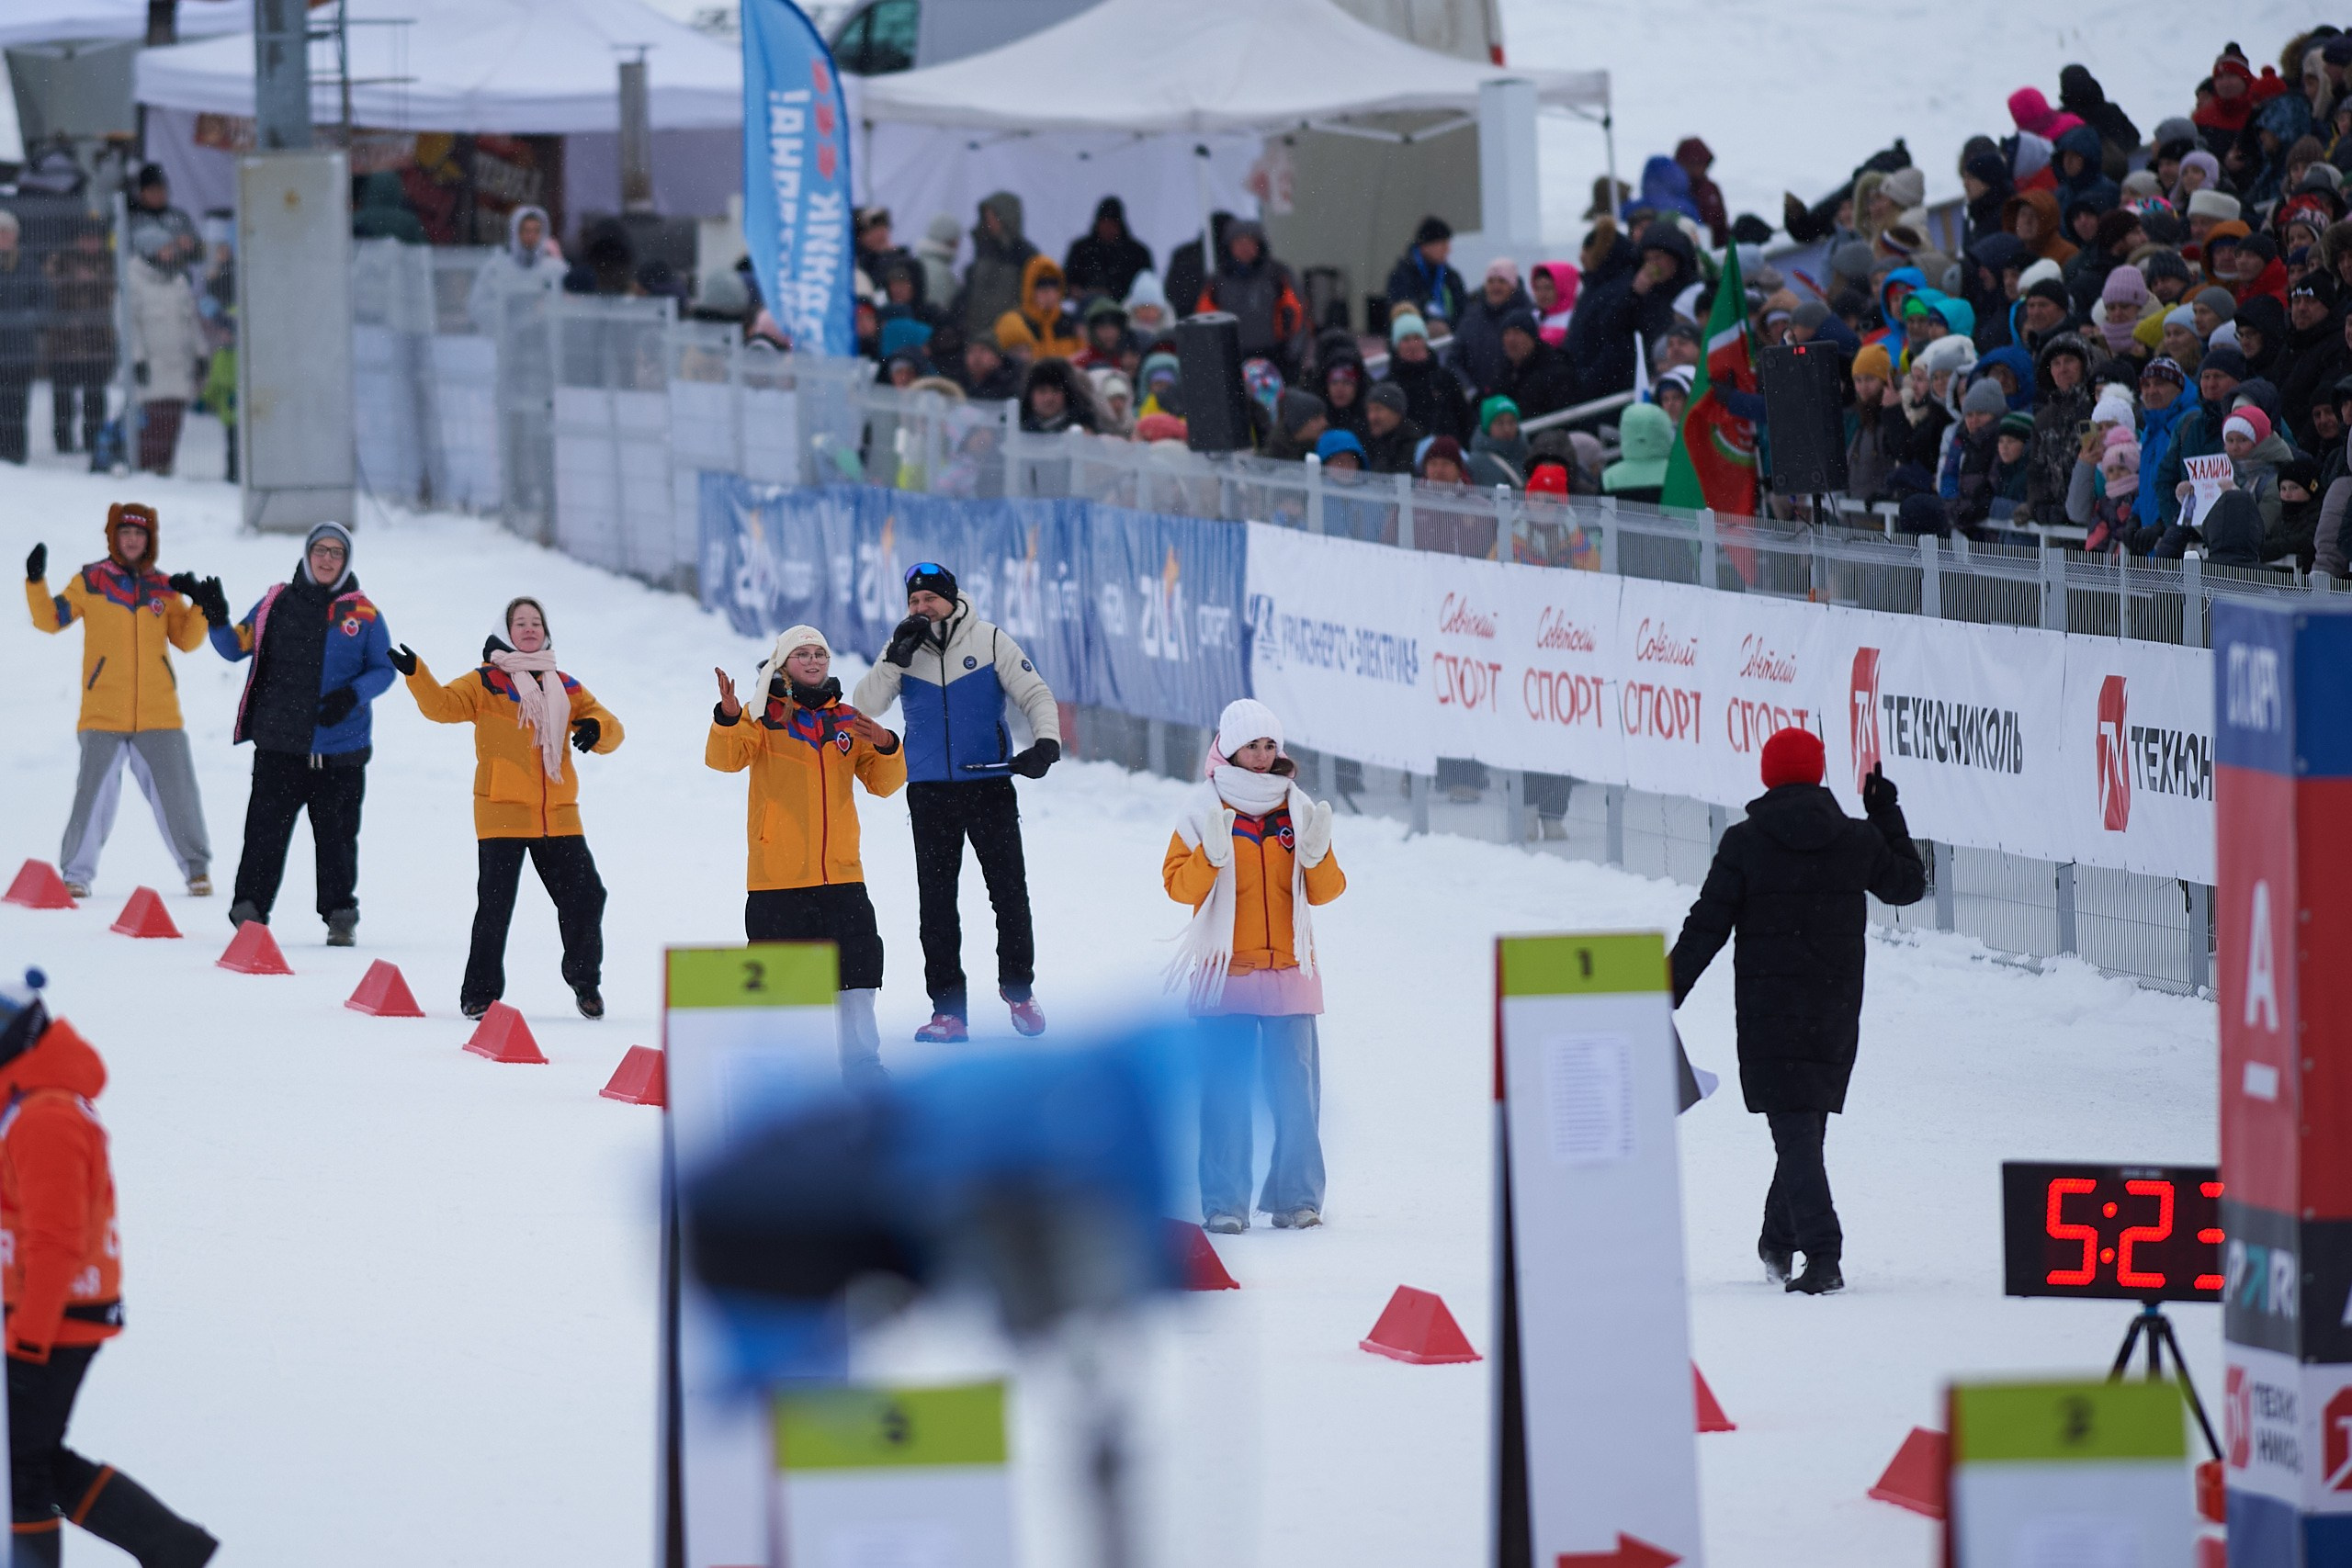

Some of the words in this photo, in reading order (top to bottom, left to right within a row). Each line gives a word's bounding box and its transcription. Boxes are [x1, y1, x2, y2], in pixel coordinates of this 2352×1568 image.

[1432, 651, 1502, 713] СПОРТ
[1523, 667, 1604, 728] СПОРТ
[1623, 680, 1702, 744] СПОРТ
[1883, 694, 2023, 774] ТЕХНОНИКОЛЬ
[2131, 725, 2215, 802] ТЕХНОН
[741, 961, 767, 993] 2
[1576, 948, 1594, 980] 1
